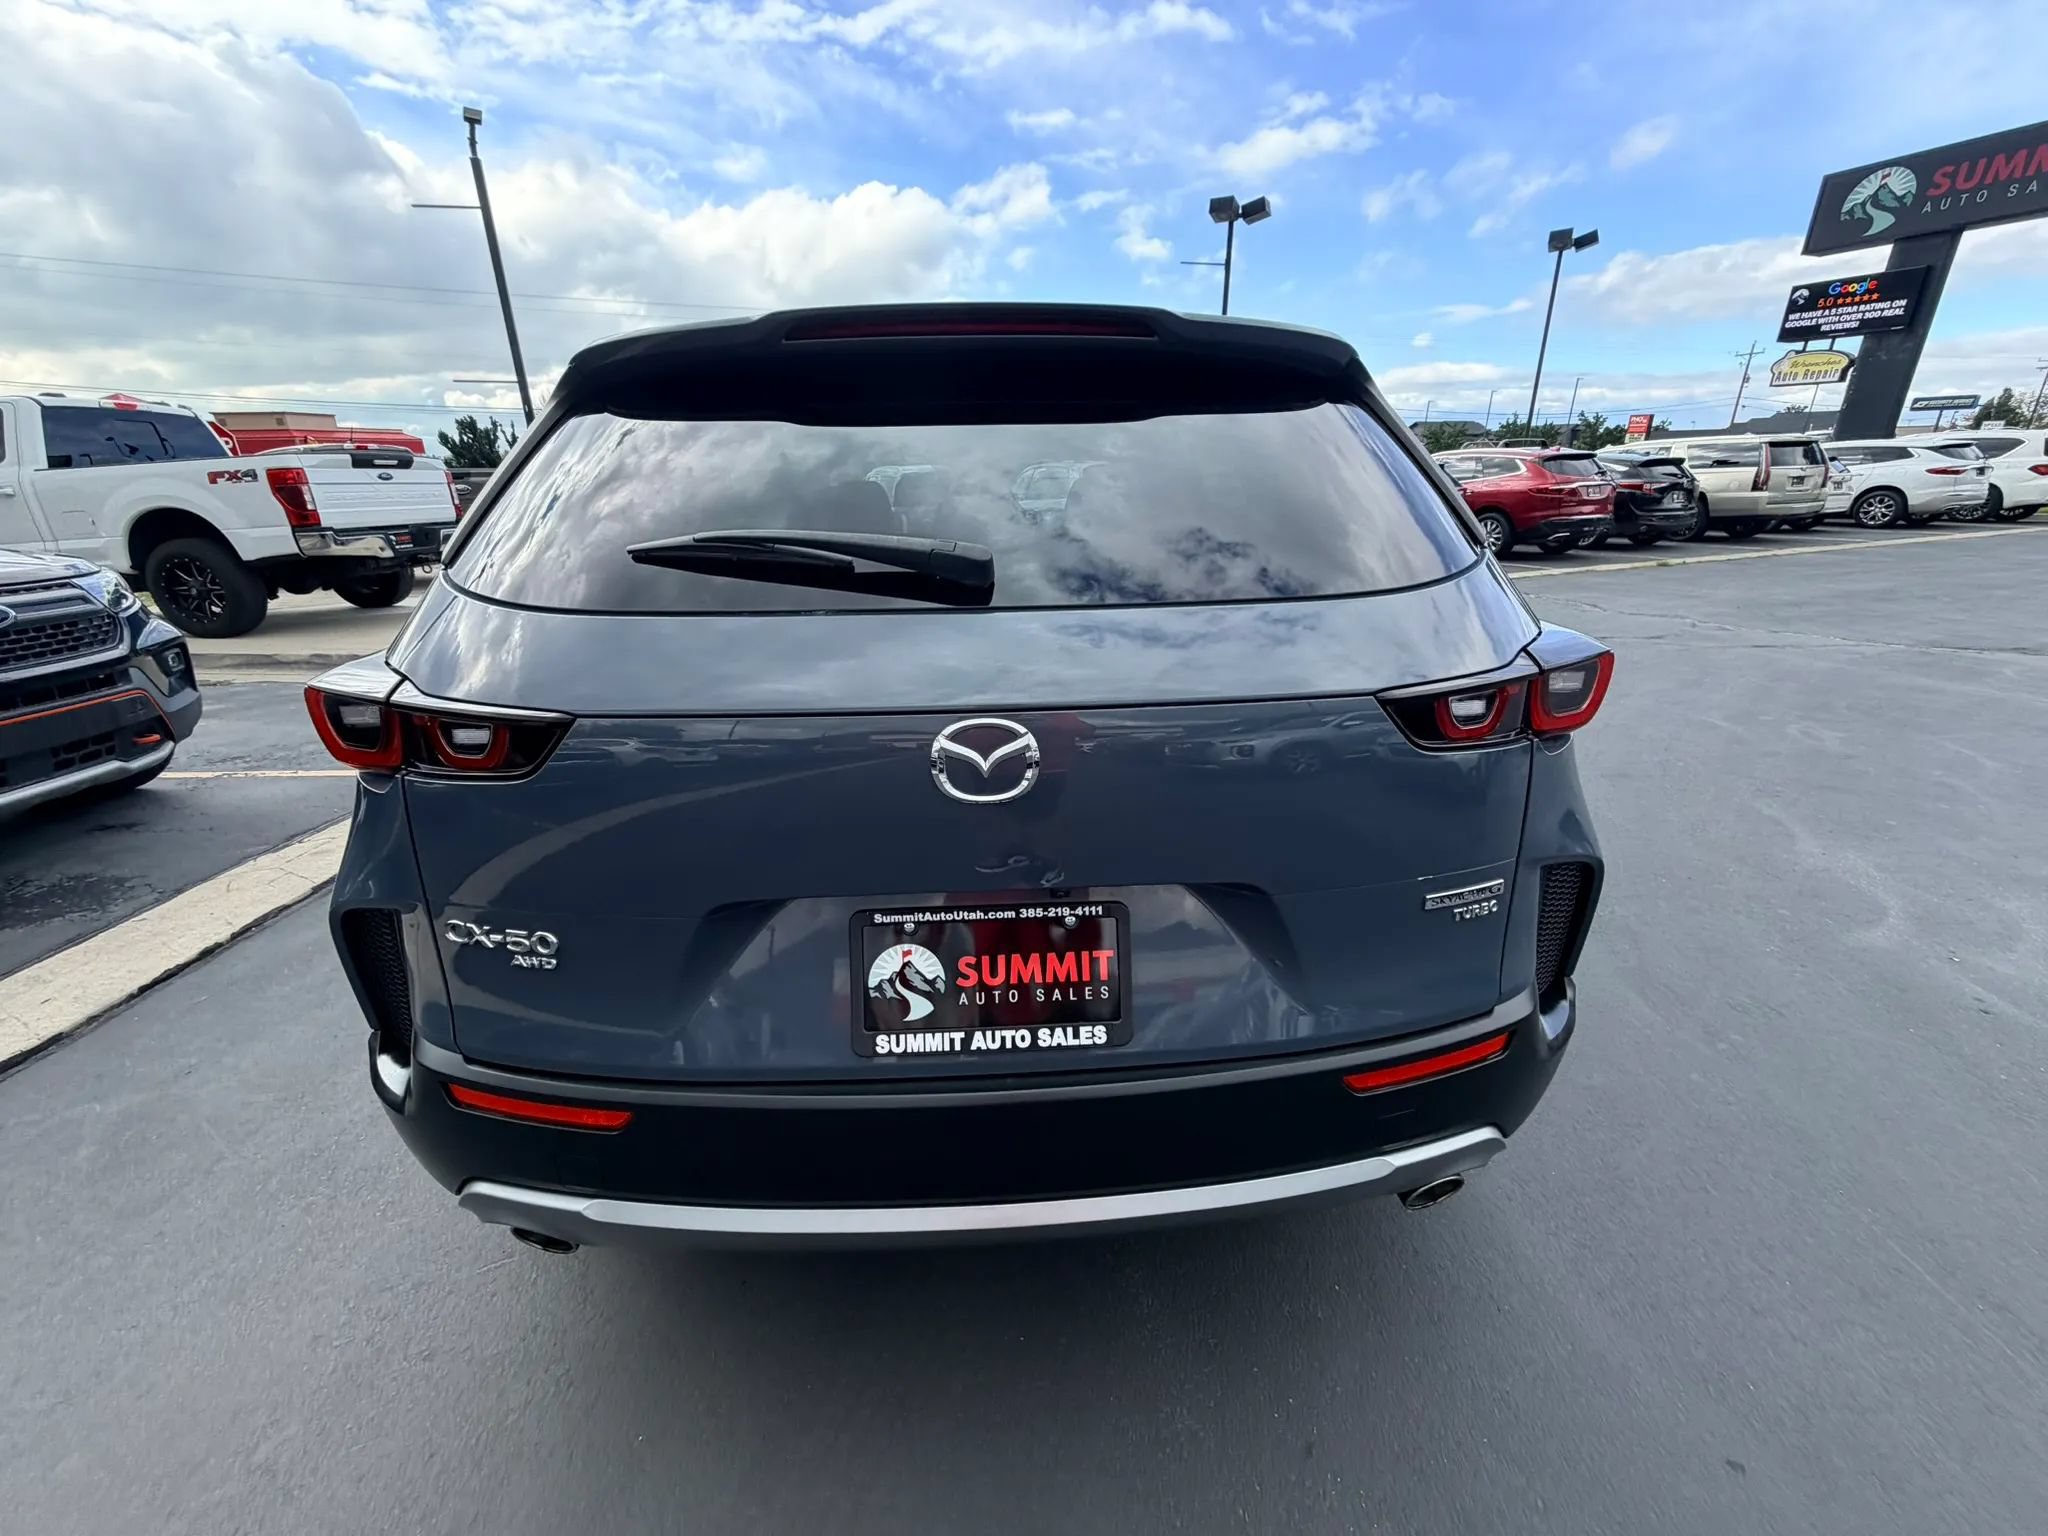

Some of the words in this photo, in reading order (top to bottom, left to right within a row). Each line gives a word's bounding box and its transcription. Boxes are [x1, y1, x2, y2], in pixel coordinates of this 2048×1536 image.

[1921, 189, 1988, 214] AUTO
[2007, 180, 2037, 197] SA
[1828, 277, 1879, 294] Google
[1788, 312, 1801, 321] WE
[1801, 309, 1822, 319] HAVE
[1823, 309, 1830, 317] A
[1830, 308, 1837, 316] 5
[1837, 306, 1858, 315] STAR
[1858, 301, 1891, 312] RATING
[1891, 299, 1907, 308] ON
[1817, 297, 1834, 307] 5.0
[1785, 319, 1817, 328] GOOGLE
[1817, 316, 1839, 325] WITH
[1839, 313, 1863, 322] OVER
[1863, 310, 1881, 319] 300
[1881, 308, 1905, 317] REAL
[1820, 321, 1860, 332] REVIEWS!
[1775, 371, 1799, 383] Auto
[1802, 367, 1839, 381] Repair
[207, 468, 258, 484] FX4
[874, 909, 1016, 924] SummitAutoUtah.com
[1019, 905, 1103, 919] 385-219-4111
[1453, 899, 1498, 921] TURBO
[445, 919, 559, 955] CX-50
[510, 954, 557, 970] AWD
[956, 950, 1114, 988] SUMMIT
[959, 989, 1019, 1006] AUTO
[1036, 986, 1109, 1002] SALES
[875, 1032, 965, 1054] SUMMIT
[970, 1028, 1031, 1050] AUTO
[1037, 1025, 1107, 1048] SALES
